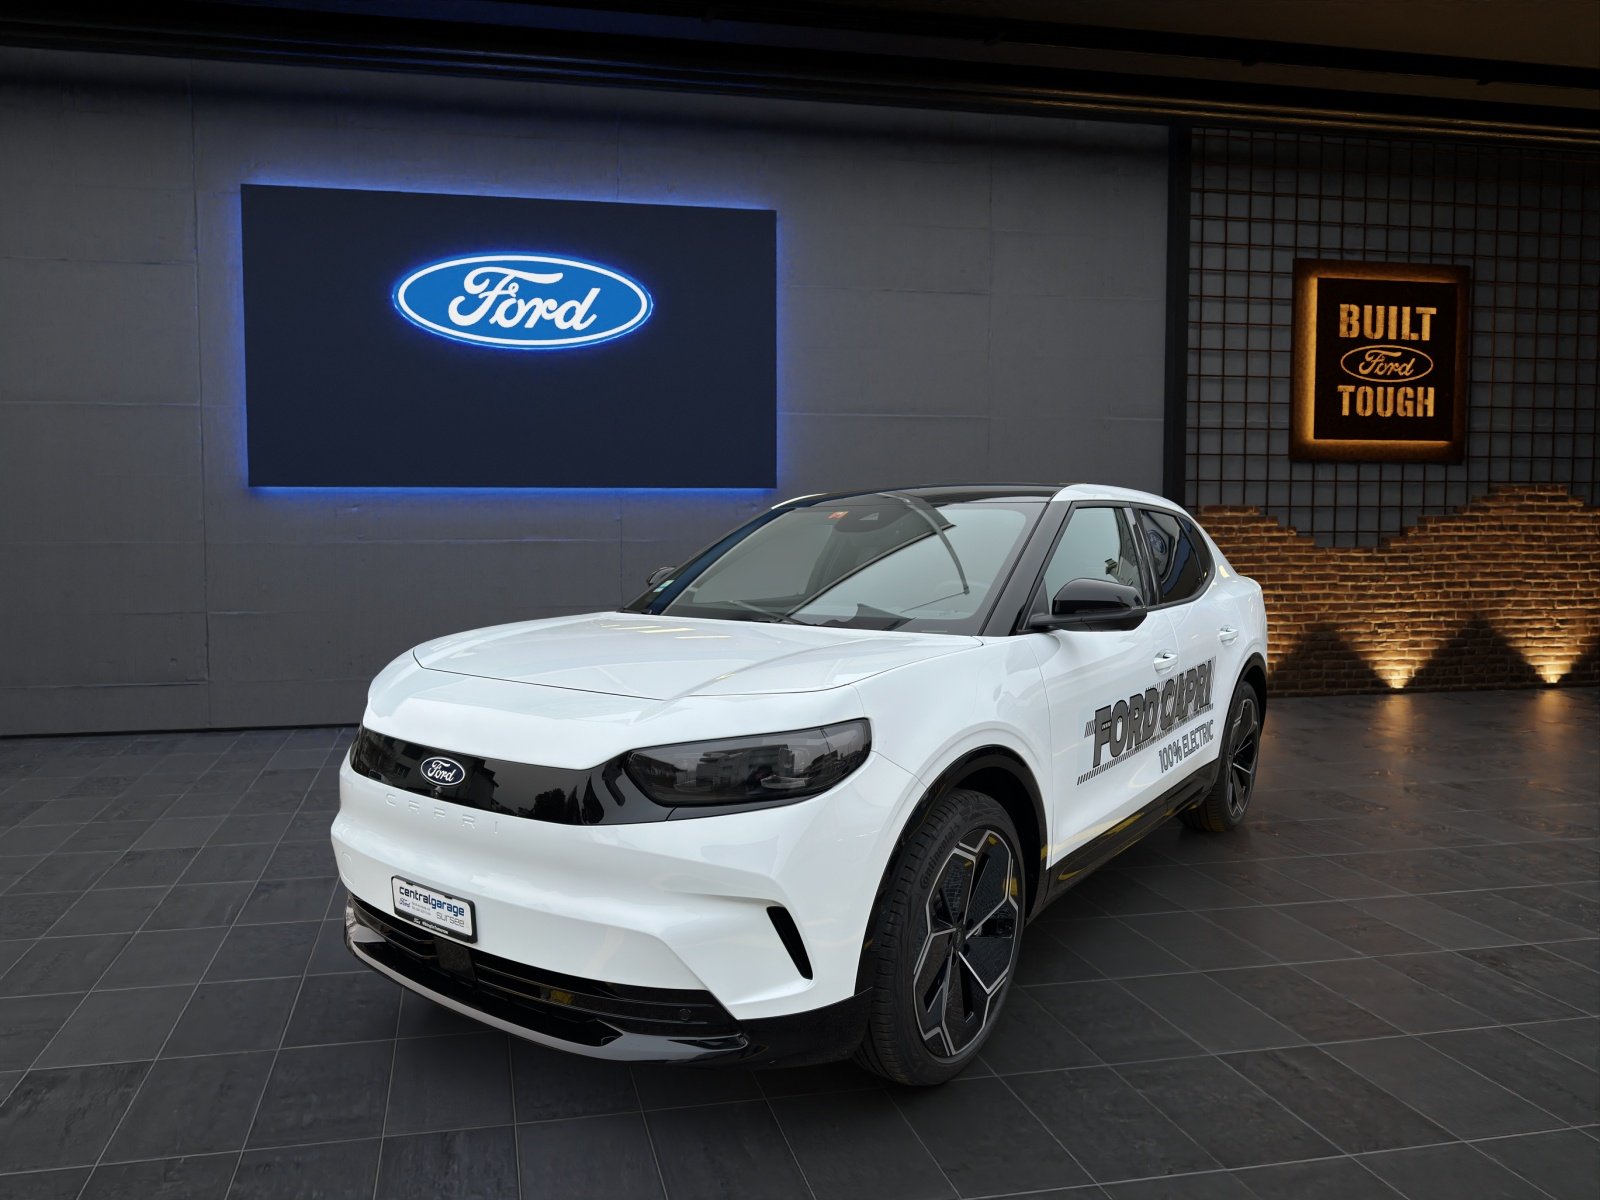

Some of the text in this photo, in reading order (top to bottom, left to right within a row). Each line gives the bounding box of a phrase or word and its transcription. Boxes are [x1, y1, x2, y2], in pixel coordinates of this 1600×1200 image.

[447, 266, 601, 331] Ford
[1338, 303, 1437, 341] BUILT
[1358, 349, 1416, 377] Ford
[1337, 385, 1435, 418] TOUGH
[1092, 659, 1212, 768] FORD CAPRI
[1158, 719, 1214, 774] 100% ELECTRIC
[427, 758, 457, 783] Ford
[385, 792, 500, 835] CAPRI
